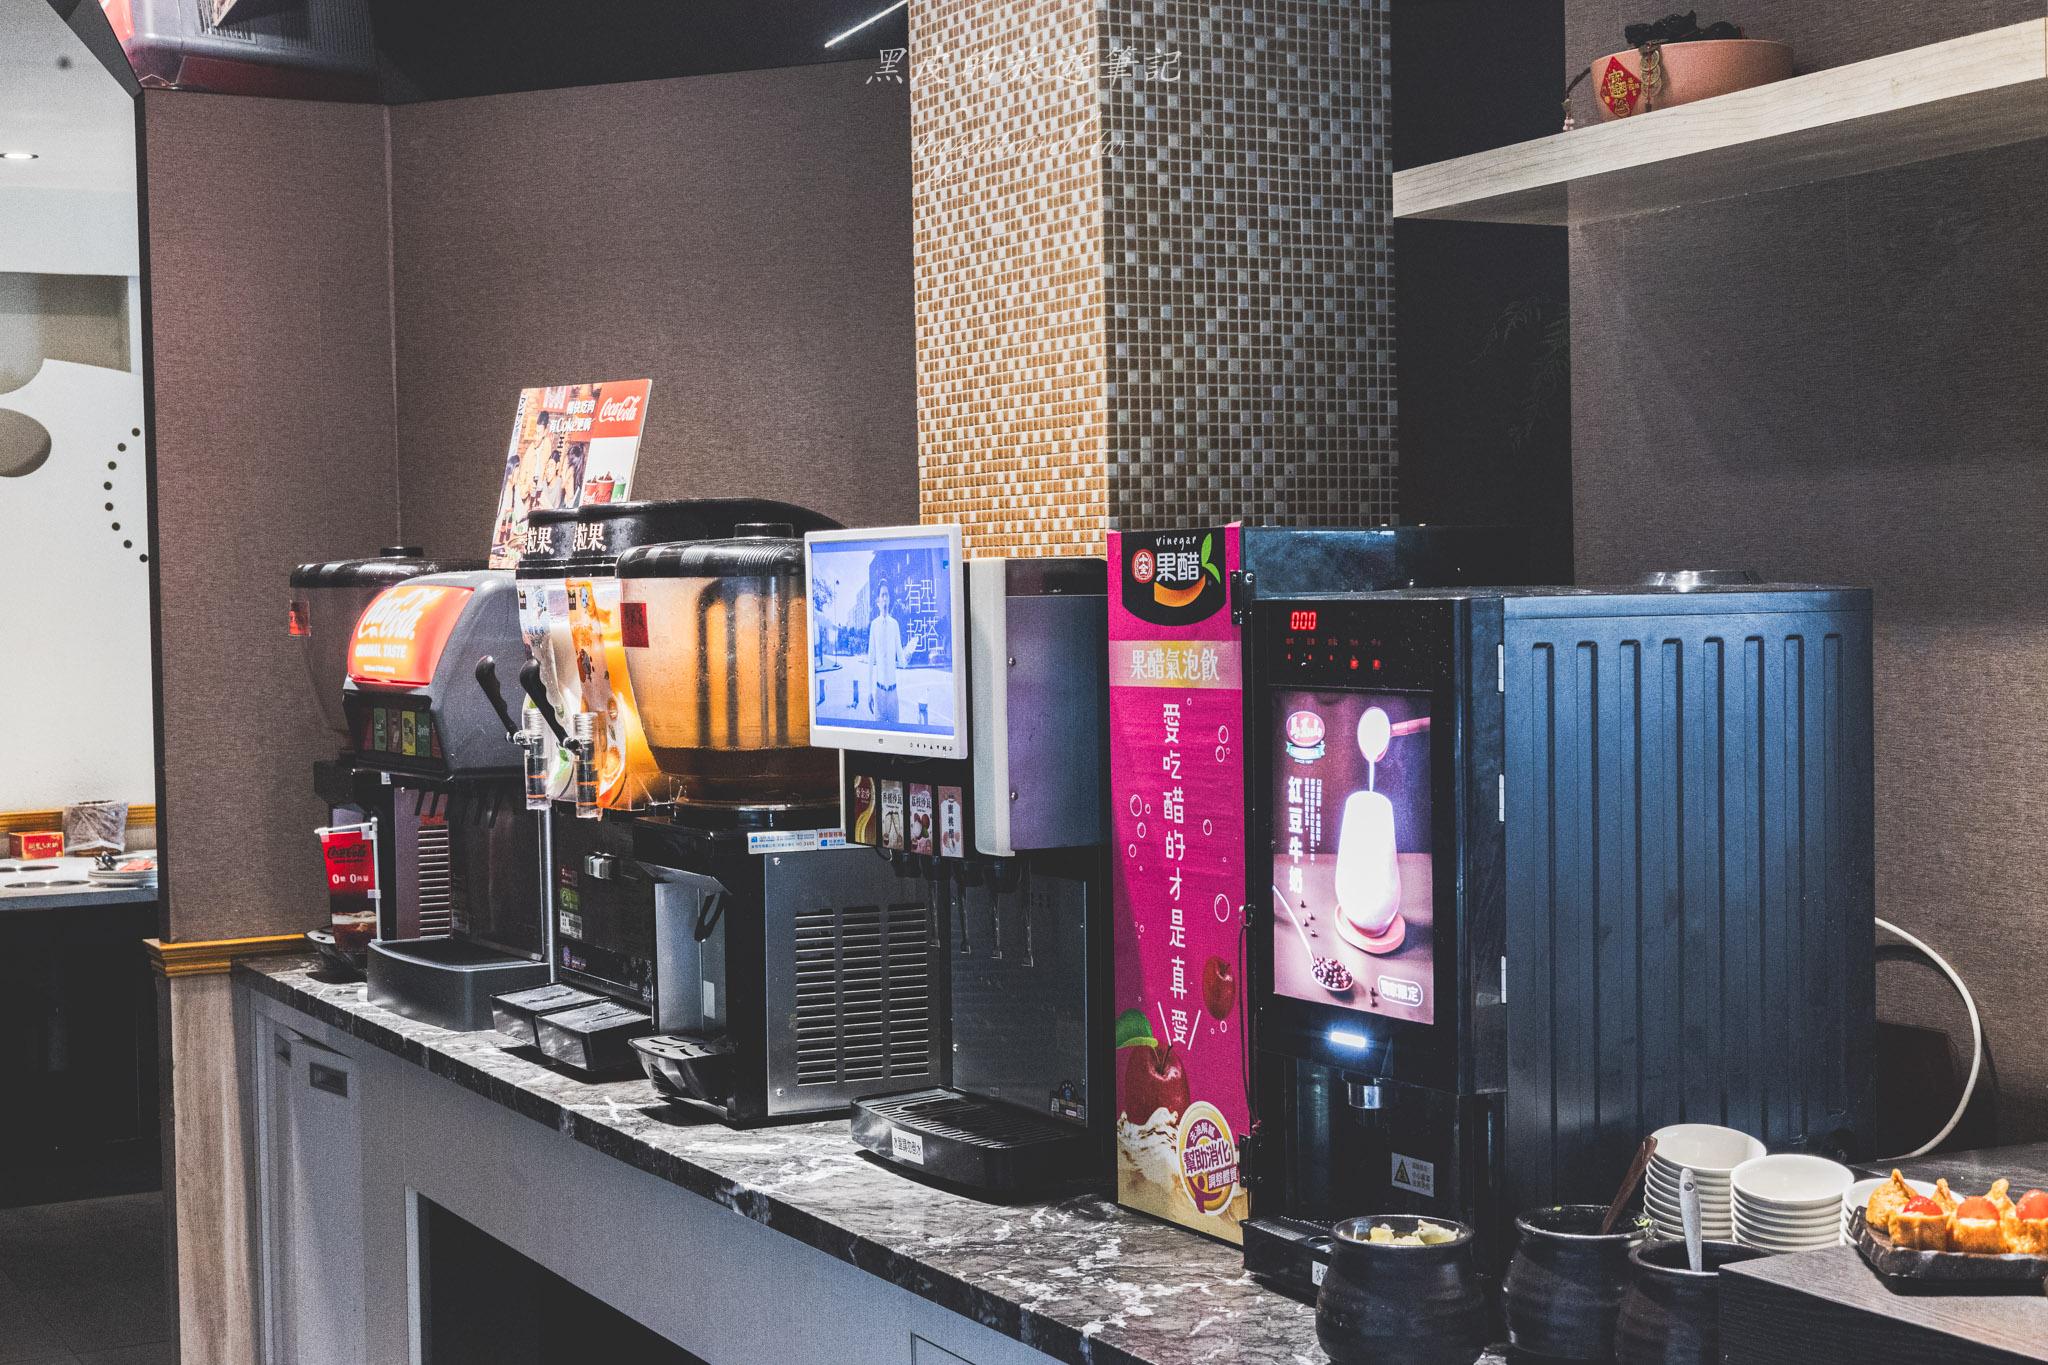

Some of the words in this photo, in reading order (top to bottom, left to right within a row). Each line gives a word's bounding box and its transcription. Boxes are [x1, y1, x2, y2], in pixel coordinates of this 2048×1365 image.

[1156, 552, 1199, 582] 果醋
[904, 578, 939, 614] 有型
[906, 616, 940, 652] 超搭
[1291, 611, 1317, 630] 000
[1130, 648, 1220, 681] 果醋氣泡飲
[1162, 703, 1188, 1045] 愛吃醋的才是真愛
[1183, 1140, 1231, 1173] 幫助消化
